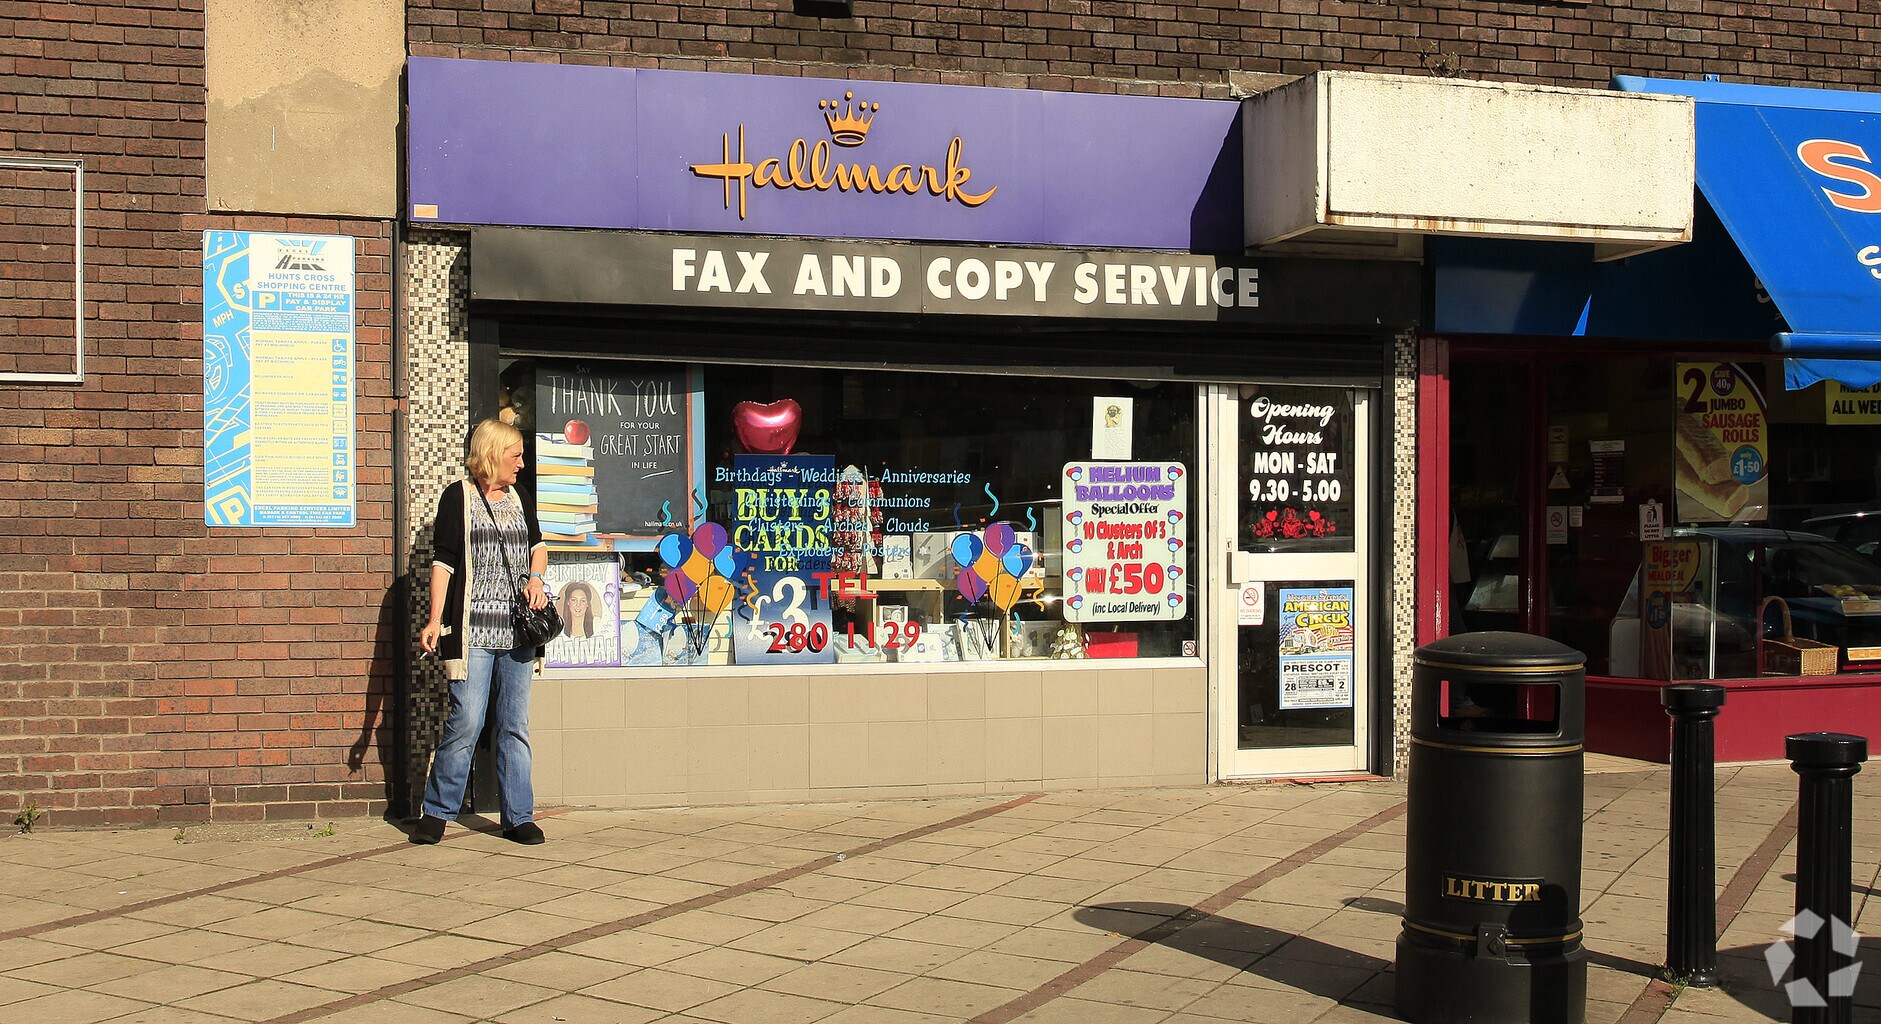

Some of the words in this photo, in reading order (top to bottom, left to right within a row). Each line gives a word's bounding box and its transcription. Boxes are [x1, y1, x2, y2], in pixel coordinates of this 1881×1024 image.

[688, 123, 998, 221] Hallmark
[1796, 138, 1881, 214] S
[257, 281, 306, 290] SHOPPING
[308, 283, 346, 292] CENTRE
[268, 272, 301, 281] HUNTS
[303, 274, 335, 282] CROSS
[672, 247, 773, 296] FAX
[792, 252, 903, 299] AND
[926, 256, 1056, 303] COPY
[1073, 262, 1260, 308] SERVICE
[258, 292, 276, 309] P
[212, 309, 235, 328] MPH
[576, 365, 590, 374] SAY
[1683, 367, 1708, 414] 2
[1716, 378, 1731, 391] 40p
[547, 375, 622, 417] THANK
[630, 380, 678, 418] YOU
[1708, 398, 1746, 414] JUMBO
[1251, 396, 1335, 427] Opening
[1832, 400, 1856, 414] ALL
[620, 422, 635, 430] FOR
[637, 422, 660, 430] YOUR
[1702, 413, 1760, 429] SAUSAGE
[1262, 424, 1323, 445] Hours
[1722, 429, 1759, 443] ROLLS
[600, 434, 639, 456] GREAT
[643, 434, 682, 457] START
[631, 461, 640, 469] IN
[642, 461, 658, 469] LIFE
[767, 465, 801, 474] Hallmark
[1254, 451, 1295, 474] MON
[1306, 452, 1337, 474] SAT
[715, 467, 782, 486] Birthdays
[801, 467, 864, 486] Weddings
[880, 468, 971, 484] Anniversaries
[1089, 466, 1161, 483] HELIUM
[1075, 484, 1175, 502] BALLOONS
[1249, 478, 1289, 502] 9.30
[1302, 479, 1341, 502] 5.00
[219, 497, 246, 524] P
[735, 488, 809, 521] BUY
[814, 488, 830, 521] 3
[745, 492, 831, 512] Christenings
[848, 493, 931, 508] Communions
[1091, 503, 1128, 518] Special
[1129, 503, 1159, 514] Offer
[748, 517, 804, 532] Clusters
[822, 517, 868, 532] Arches
[886, 517, 930, 532] Clouds
[1083, 521, 1095, 540] 10
[1097, 521, 1142, 540] Clusters
[1144, 520, 1158, 539] Of
[1159, 521, 1166, 539] 3
[734, 525, 830, 552] CARDS
[780, 543, 845, 560] Exploders
[862, 542, 911, 557] Posters
[1107, 541, 1115, 560] &
[1117, 540, 1143, 560] Arch
[1652, 546, 1692, 568] Bigger
[546, 563, 609, 584] BIRTHDAY
[764, 556, 799, 572] FOR
[812, 571, 879, 600] TEL
[1109, 562, 1164, 595] £50
[1092, 602, 1106, 616] (inc
[1108, 601, 1127, 614] Local
[1129, 601, 1161, 616] Delivery)
[1283, 601, 1350, 612] AMERICAN
[1296, 612, 1349, 630] CIRCUS
[768, 621, 828, 652] 280
[545, 635, 619, 665] HANNAH
[1283, 663, 1340, 673] PRESCOT
[1284, 682, 1297, 692] 28
[1338, 680, 1345, 690] 2
[1446, 877, 1541, 902] LITTER
